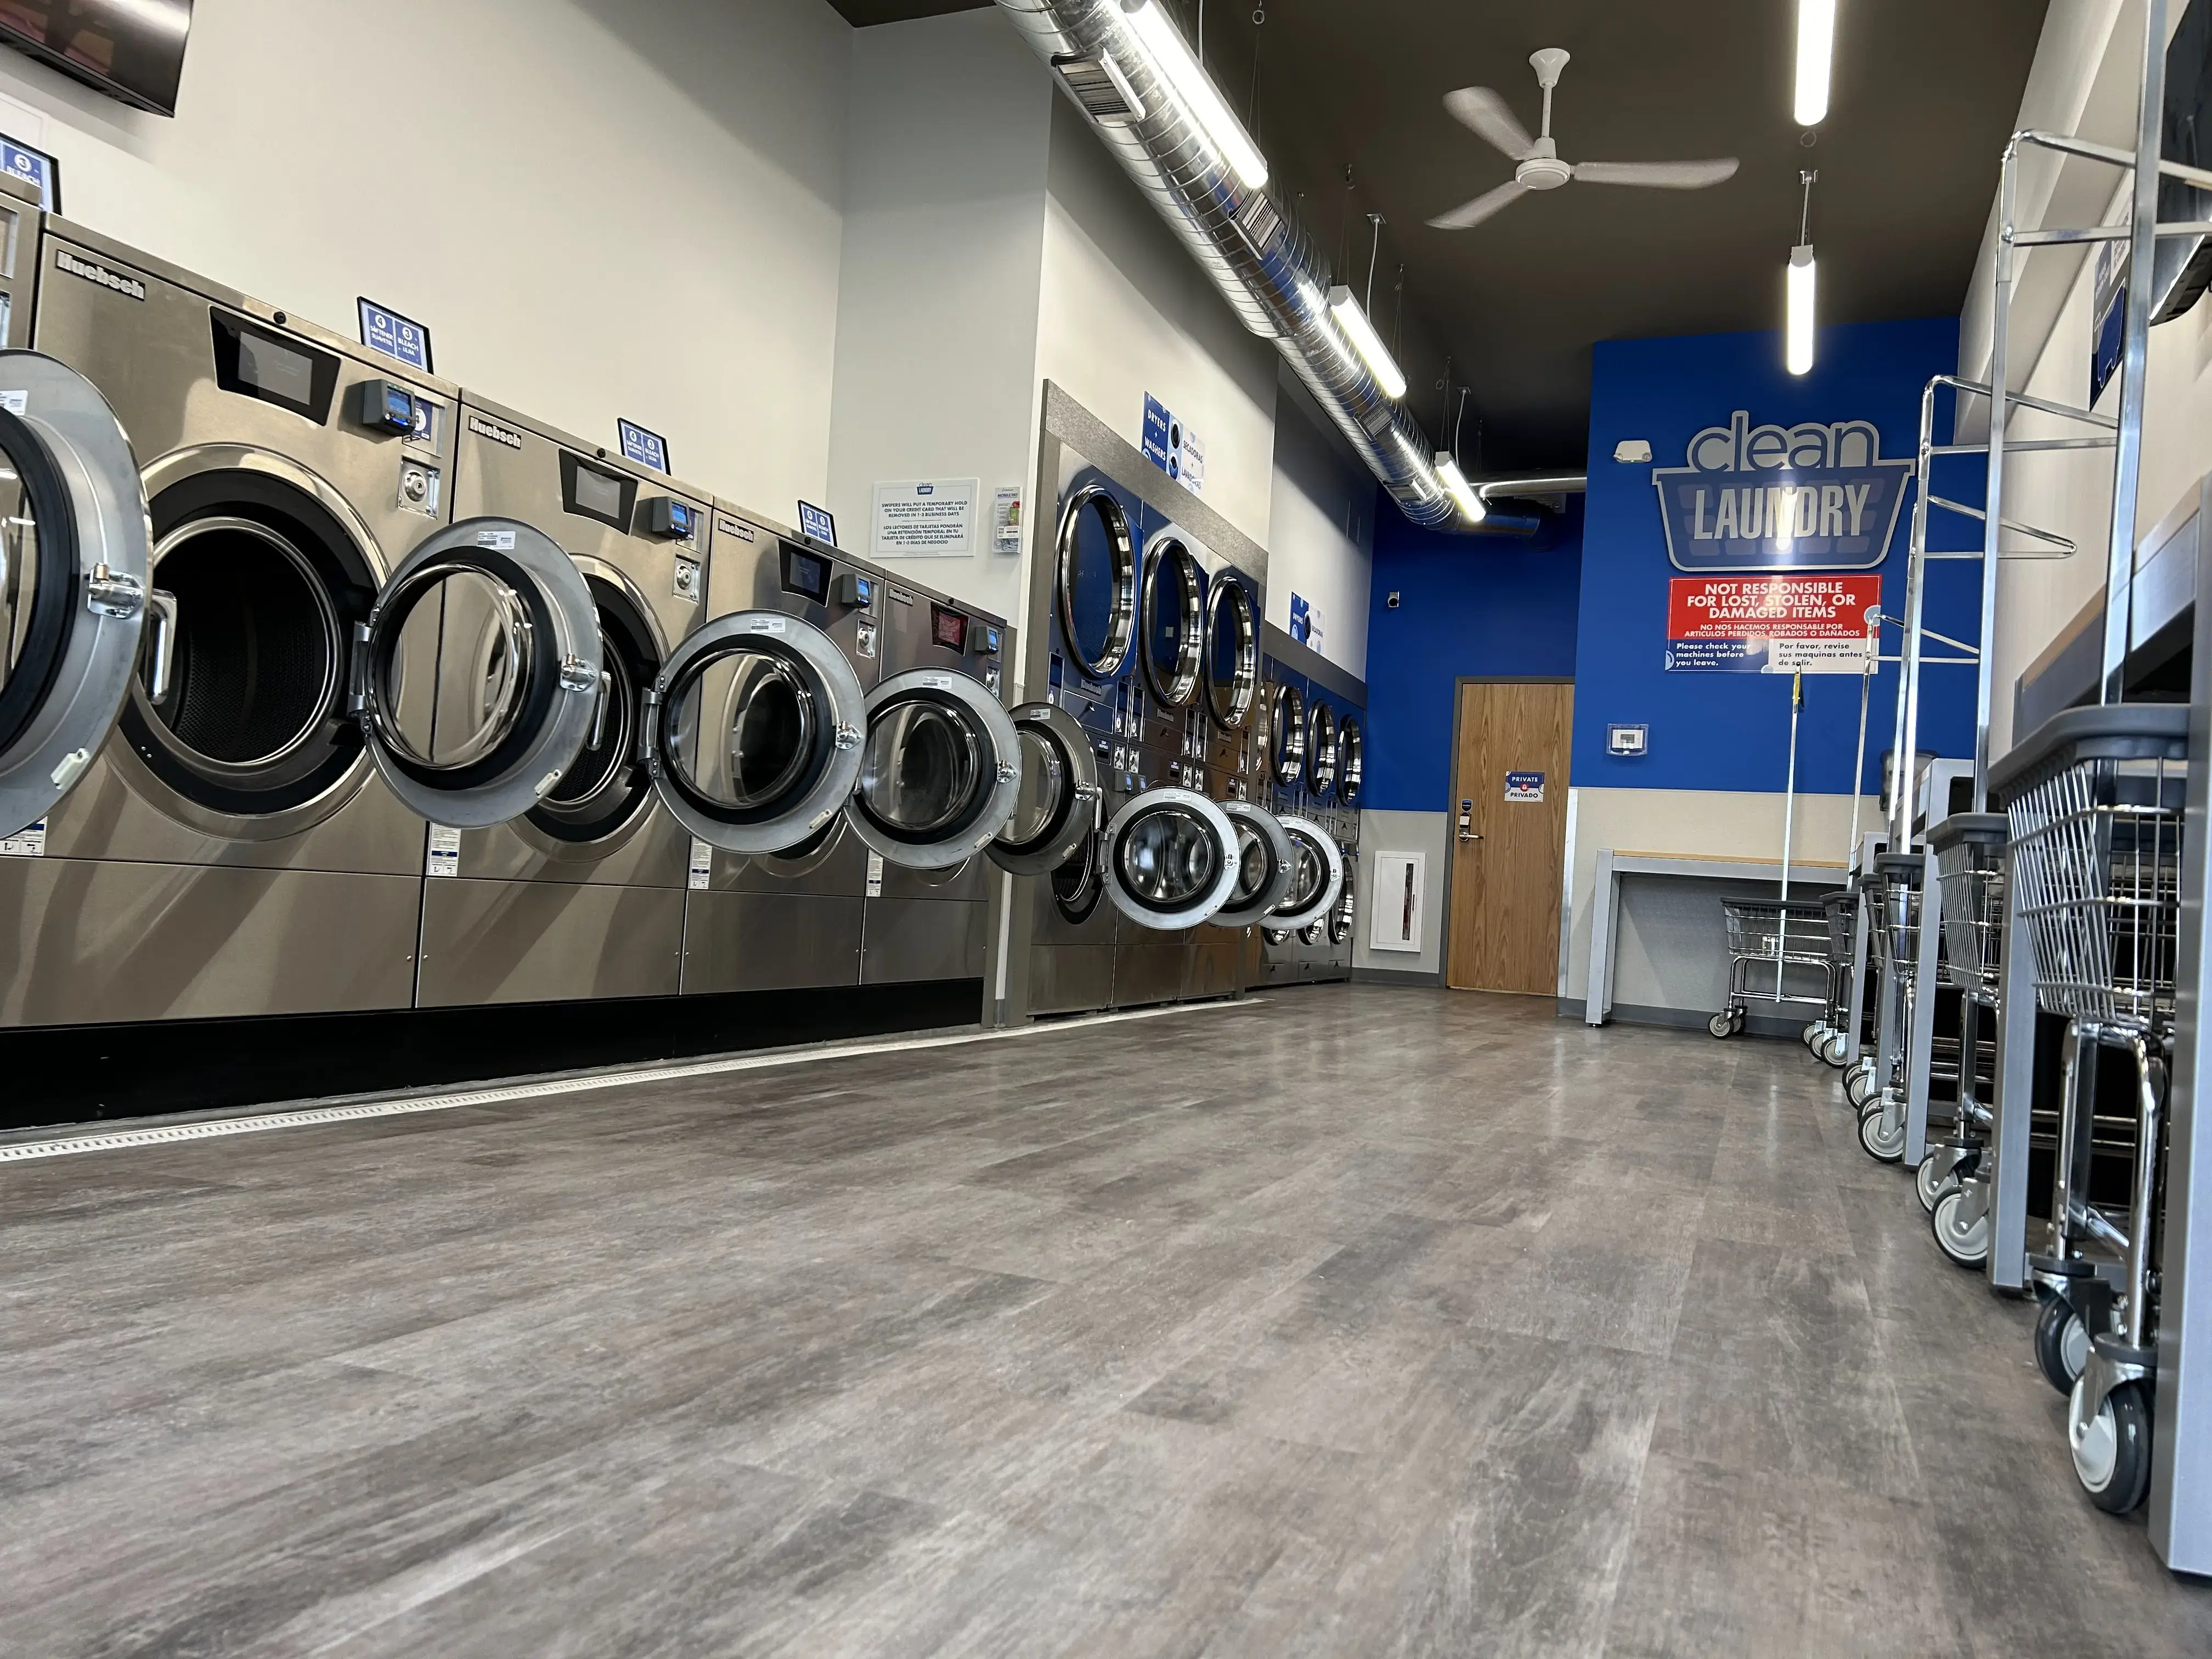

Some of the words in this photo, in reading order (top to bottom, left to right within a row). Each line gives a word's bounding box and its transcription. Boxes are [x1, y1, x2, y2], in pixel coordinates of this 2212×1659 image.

[57, 250, 145, 299] Huebsch
[398, 337, 419, 351] BLEACH
[1148, 409, 1166, 432] DRYERS
[470, 417, 521, 448] Huebsch
[1691, 416, 1875, 472] clean
[1144, 436, 1166, 461] WASHERS
[1183, 439, 1203, 464] SECADORAS
[1694, 484, 1871, 540] LAUNDRY
[1705, 583, 1738, 595] NOT
[1742, 582, 1843, 594] RESPONSIBLE
[1687, 596, 1716, 607] FOR
[1722, 595, 1759, 607] LOST,
[1765, 594, 1826, 607] STOLEN,
[1832, 594, 1856, 606] OR
[1709, 607, 1787, 619] DAMAGED
[1792, 606, 1836, 618] ITEMS
[1819, 628, 1860, 636] DAÑADOS
[1795, 651, 1836, 659] maquinas
